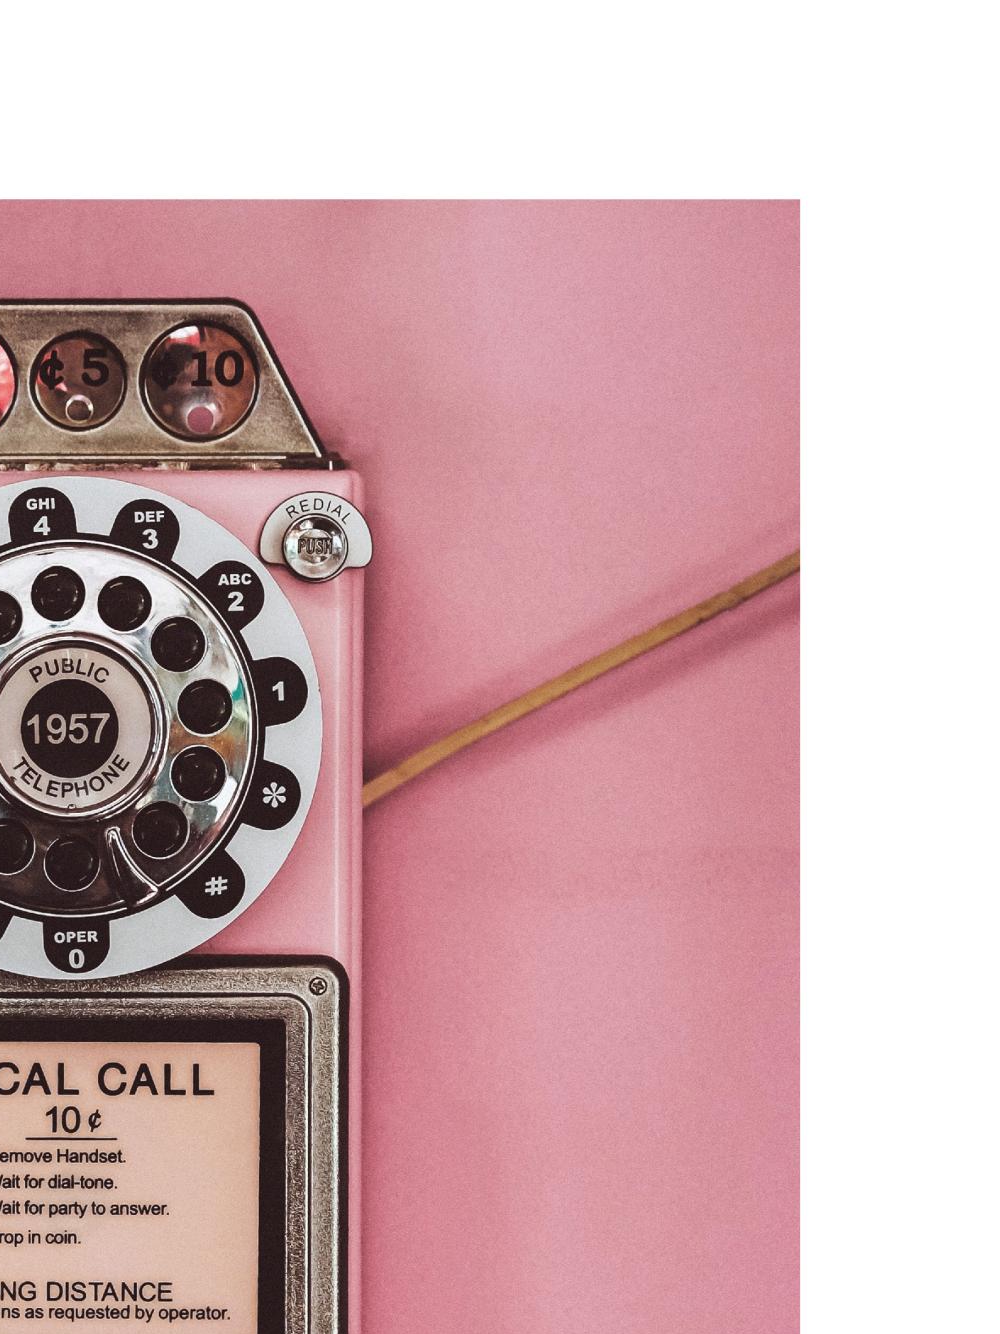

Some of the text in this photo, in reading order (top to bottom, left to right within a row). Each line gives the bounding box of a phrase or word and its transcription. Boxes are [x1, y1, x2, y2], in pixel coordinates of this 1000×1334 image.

[81, 348, 110, 387] 5
[191, 351, 244, 387] 10
[26, 497, 56, 511] GHI
[285, 498, 351, 525] REDIAL
[33, 515, 51, 536] 4
[134, 510, 165, 523] DEF
[142, 528, 159, 550] 3
[297, 537, 334, 555] PUSH
[217, 571, 253, 586] ABC
[227, 591, 245, 612] 2
[28, 658, 110, 684] PUBLIC
[272, 680, 285, 702] 1
[26, 712, 111, 745] 1957
[13, 754, 130, 798] TELEPHONE
[53, 930, 99, 944] OPER
[68, 948, 85, 969] 0
[97, 1061, 215, 1097] CALL
[45, 1105, 102, 1134] 10 ¢
[56, 1148, 127, 1164] Handset.
[23, 1174, 45, 1189] for
[47, 1174, 118, 1190] dial-tone.
[23, 1199, 46, 1216] for
[48, 1201, 88, 1219] party
[90, 1201, 107, 1216] to
[109, 1204, 170, 1216] answer.
[28, 1229, 41, 1245] in
[44, 1229, 81, 1245] coin.
[46, 1281, 173, 1303] DISTANCE
[24, 1307, 45, 1319] as
[48, 1304, 131, 1323] requested
[134, 1304, 155, 1324] by
[158, 1305, 231, 1324] operator.
